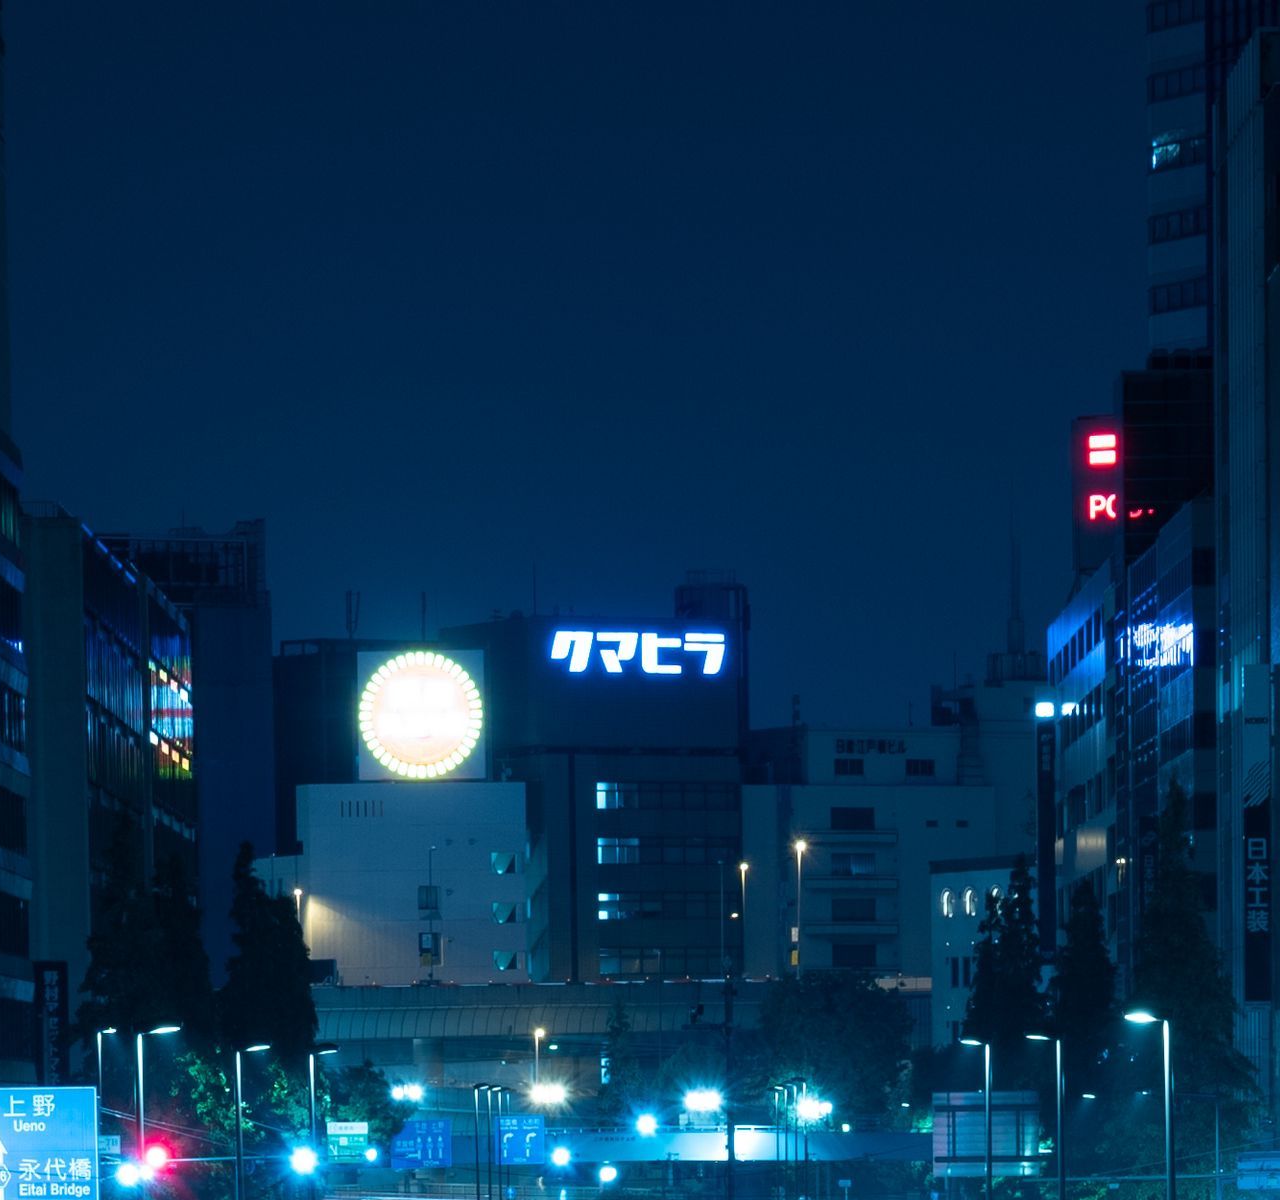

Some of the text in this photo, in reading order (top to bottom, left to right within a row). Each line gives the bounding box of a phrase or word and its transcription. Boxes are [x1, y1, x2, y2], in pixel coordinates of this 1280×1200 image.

[551, 630, 726, 675] クマヒラ
[1247, 837, 1269, 932] 日本工装
[3, 1094, 55, 1117] 上野
[13, 1120, 46, 1132] Ueno
[18, 1158, 92, 1181] 永代橋
[19, 1183, 90, 1198] Eitai Bridge
